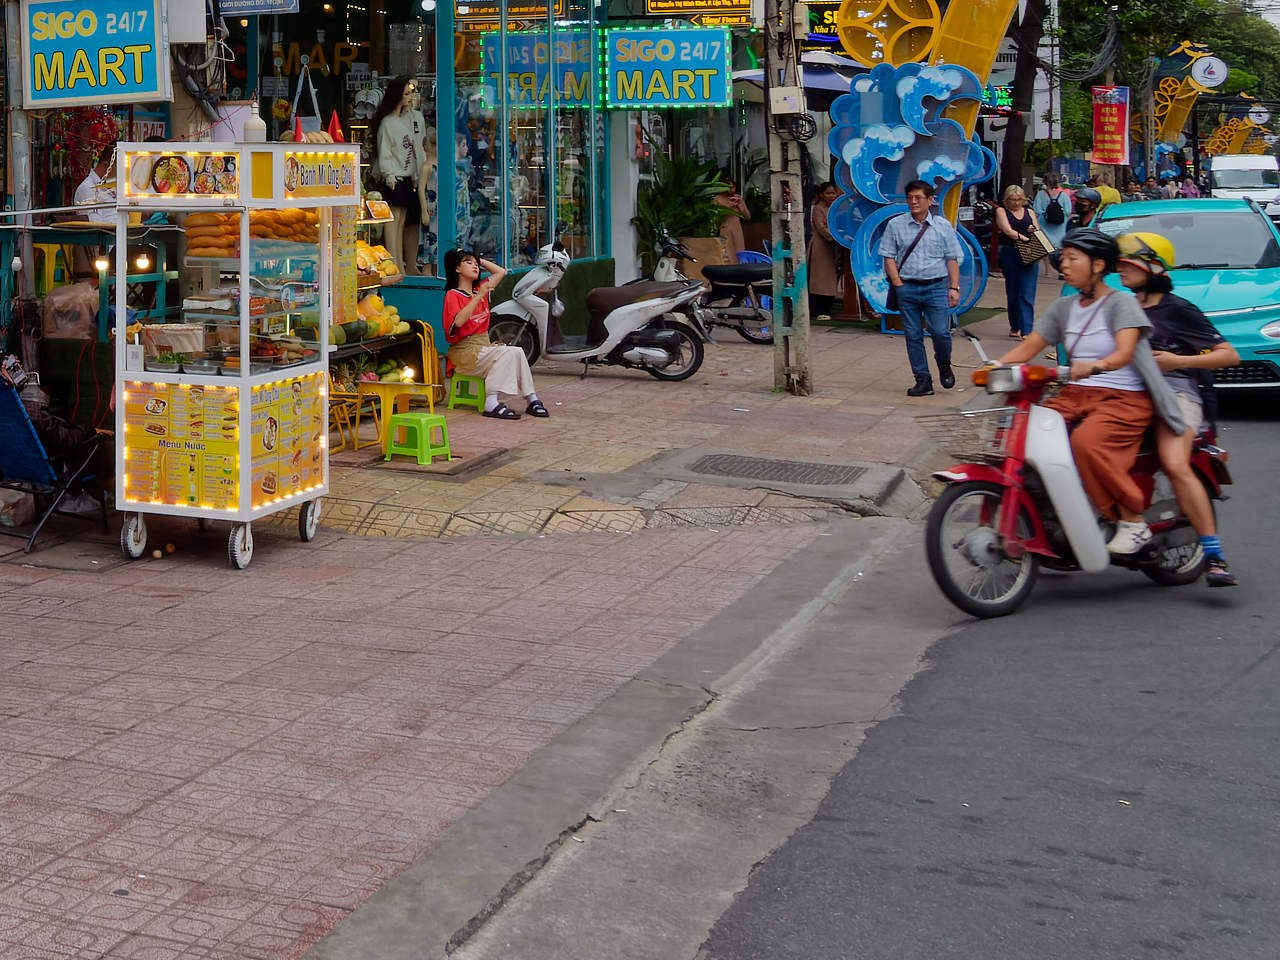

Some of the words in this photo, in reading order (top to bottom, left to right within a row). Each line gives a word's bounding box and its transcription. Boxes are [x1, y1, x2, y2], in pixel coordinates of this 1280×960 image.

[32, 9, 97, 40] SIGO
[106, 10, 148, 34] 24/7
[615, 38, 676, 62] SIGO
[680, 40, 721, 61] 24/7
[34, 44, 152, 91] MART
[616, 68, 718, 101] MART
[158, 439, 181, 449] Menu
